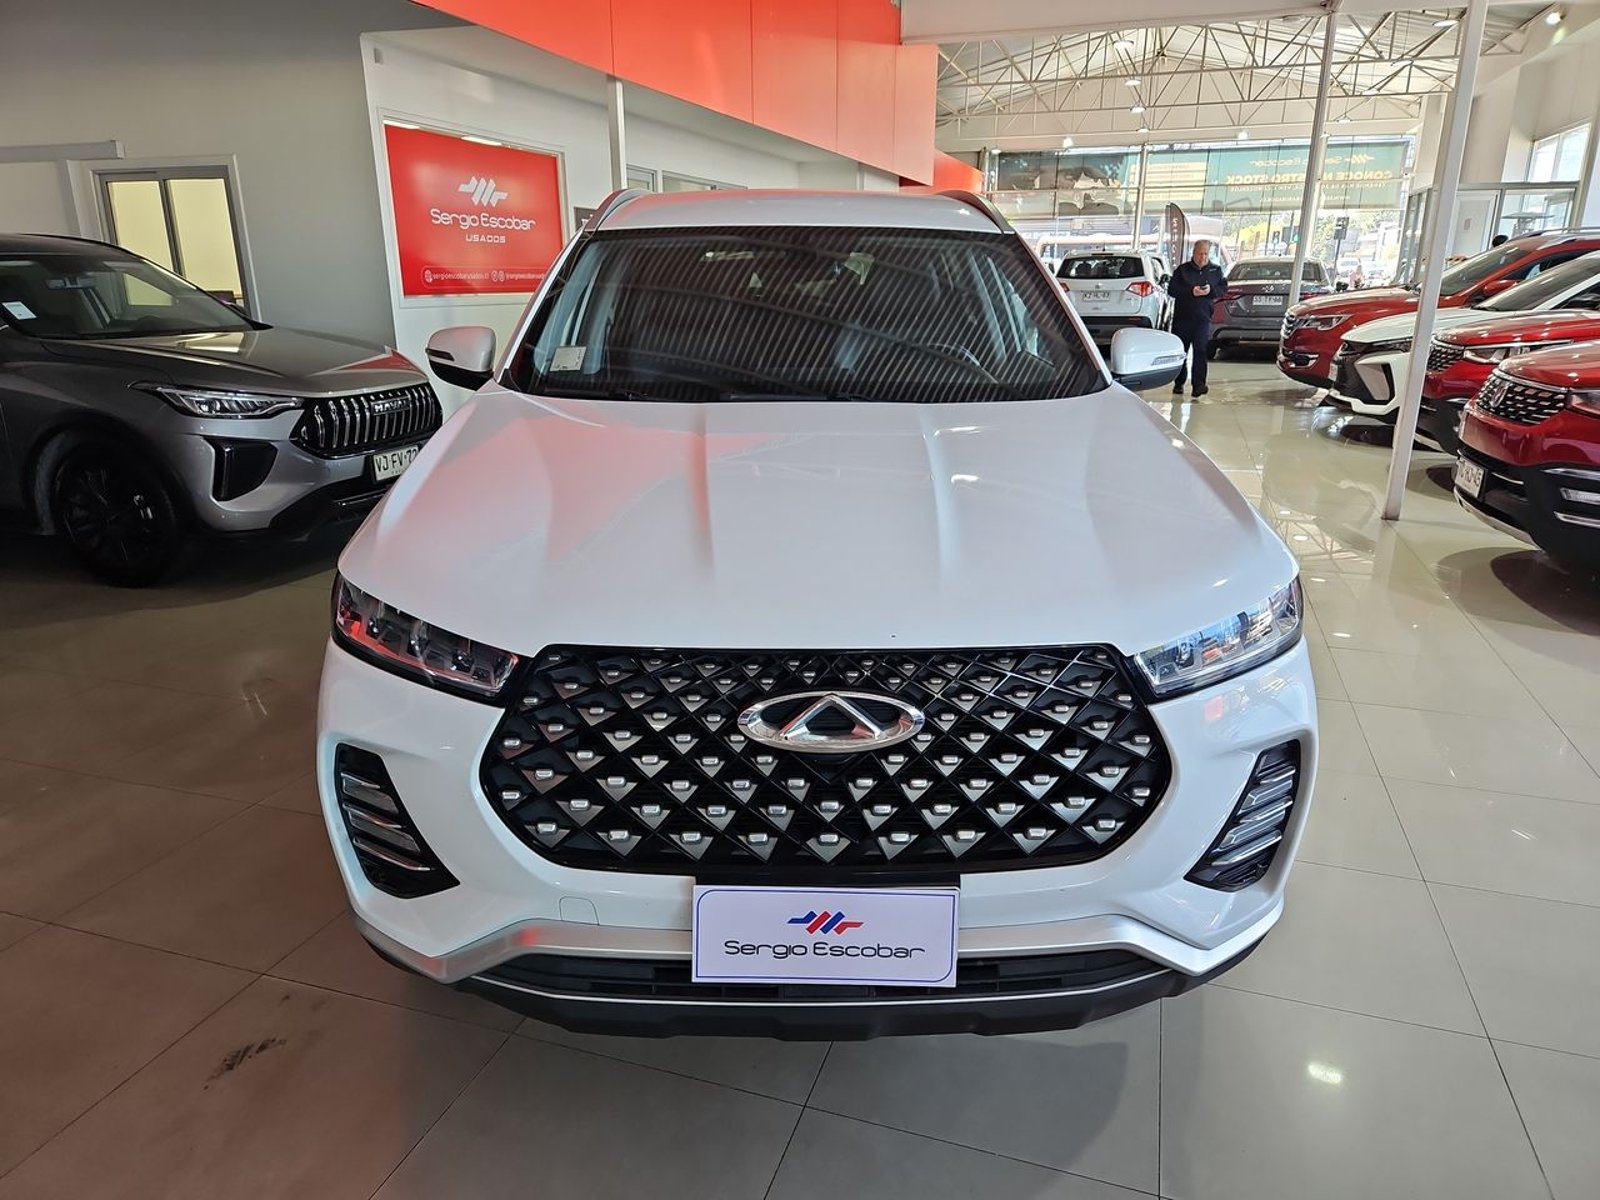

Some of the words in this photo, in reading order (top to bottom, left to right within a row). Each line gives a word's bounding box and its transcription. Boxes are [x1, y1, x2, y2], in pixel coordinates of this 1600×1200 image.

[480, 212, 536, 230] Escobar
[465, 233, 506, 243] USADOS
[724, 940, 807, 959] Sergio
[813, 941, 926, 959] Escobar
